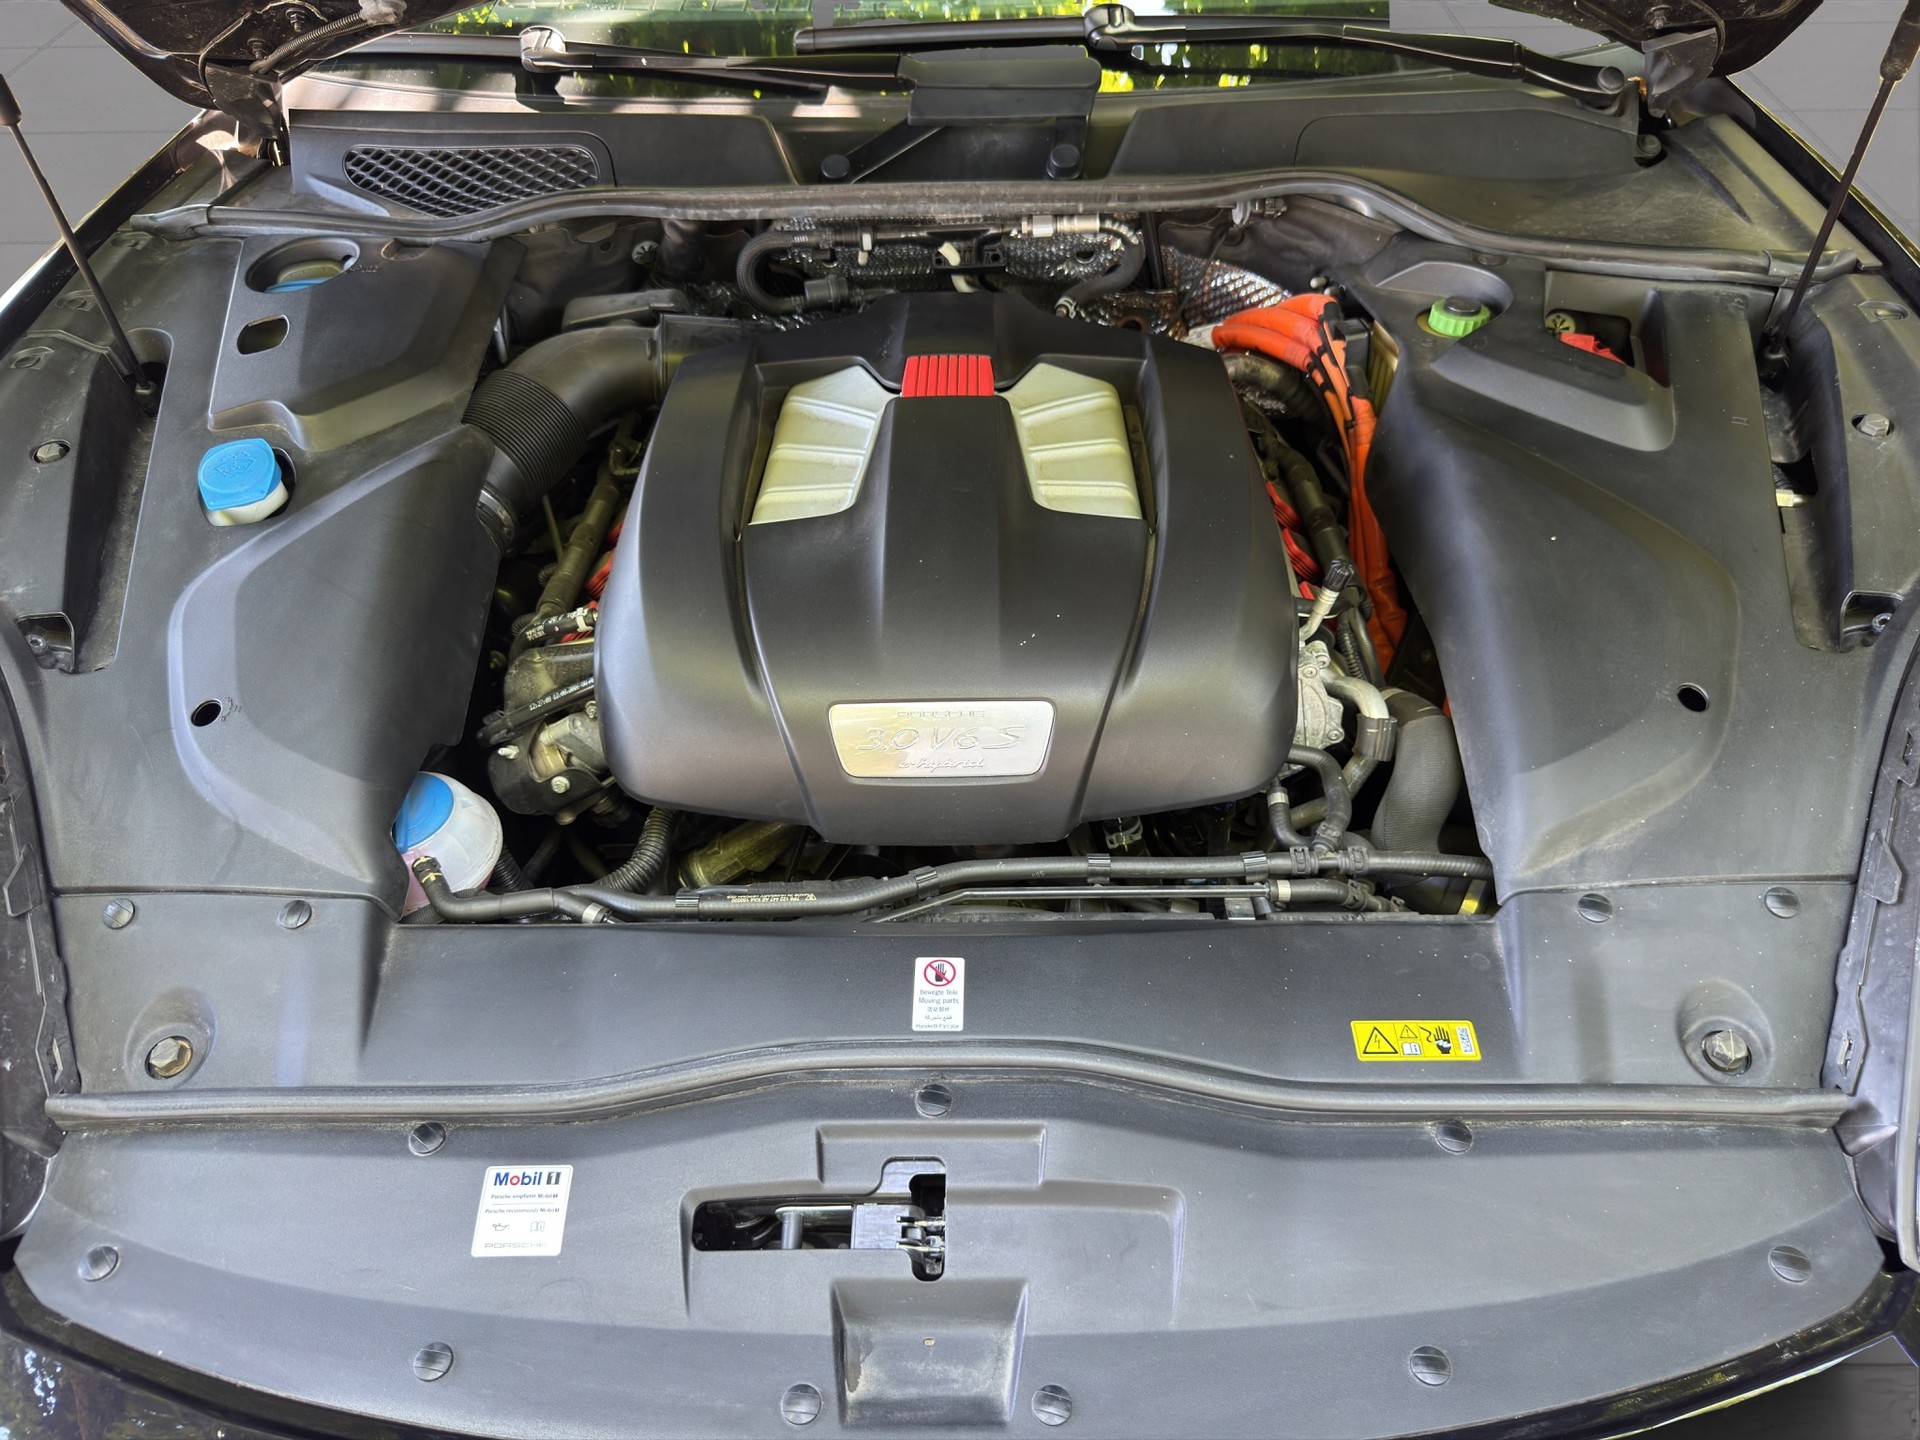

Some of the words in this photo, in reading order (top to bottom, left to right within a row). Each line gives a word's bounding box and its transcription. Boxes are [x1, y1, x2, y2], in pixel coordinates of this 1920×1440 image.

[931, 726, 980, 750] V6
[981, 725, 1027, 750] S
[898, 757, 985, 773] e-hybrid
[918, 996, 941, 1004] Moving
[494, 1172, 542, 1186] Mobil
[546, 1172, 561, 1185] 1
